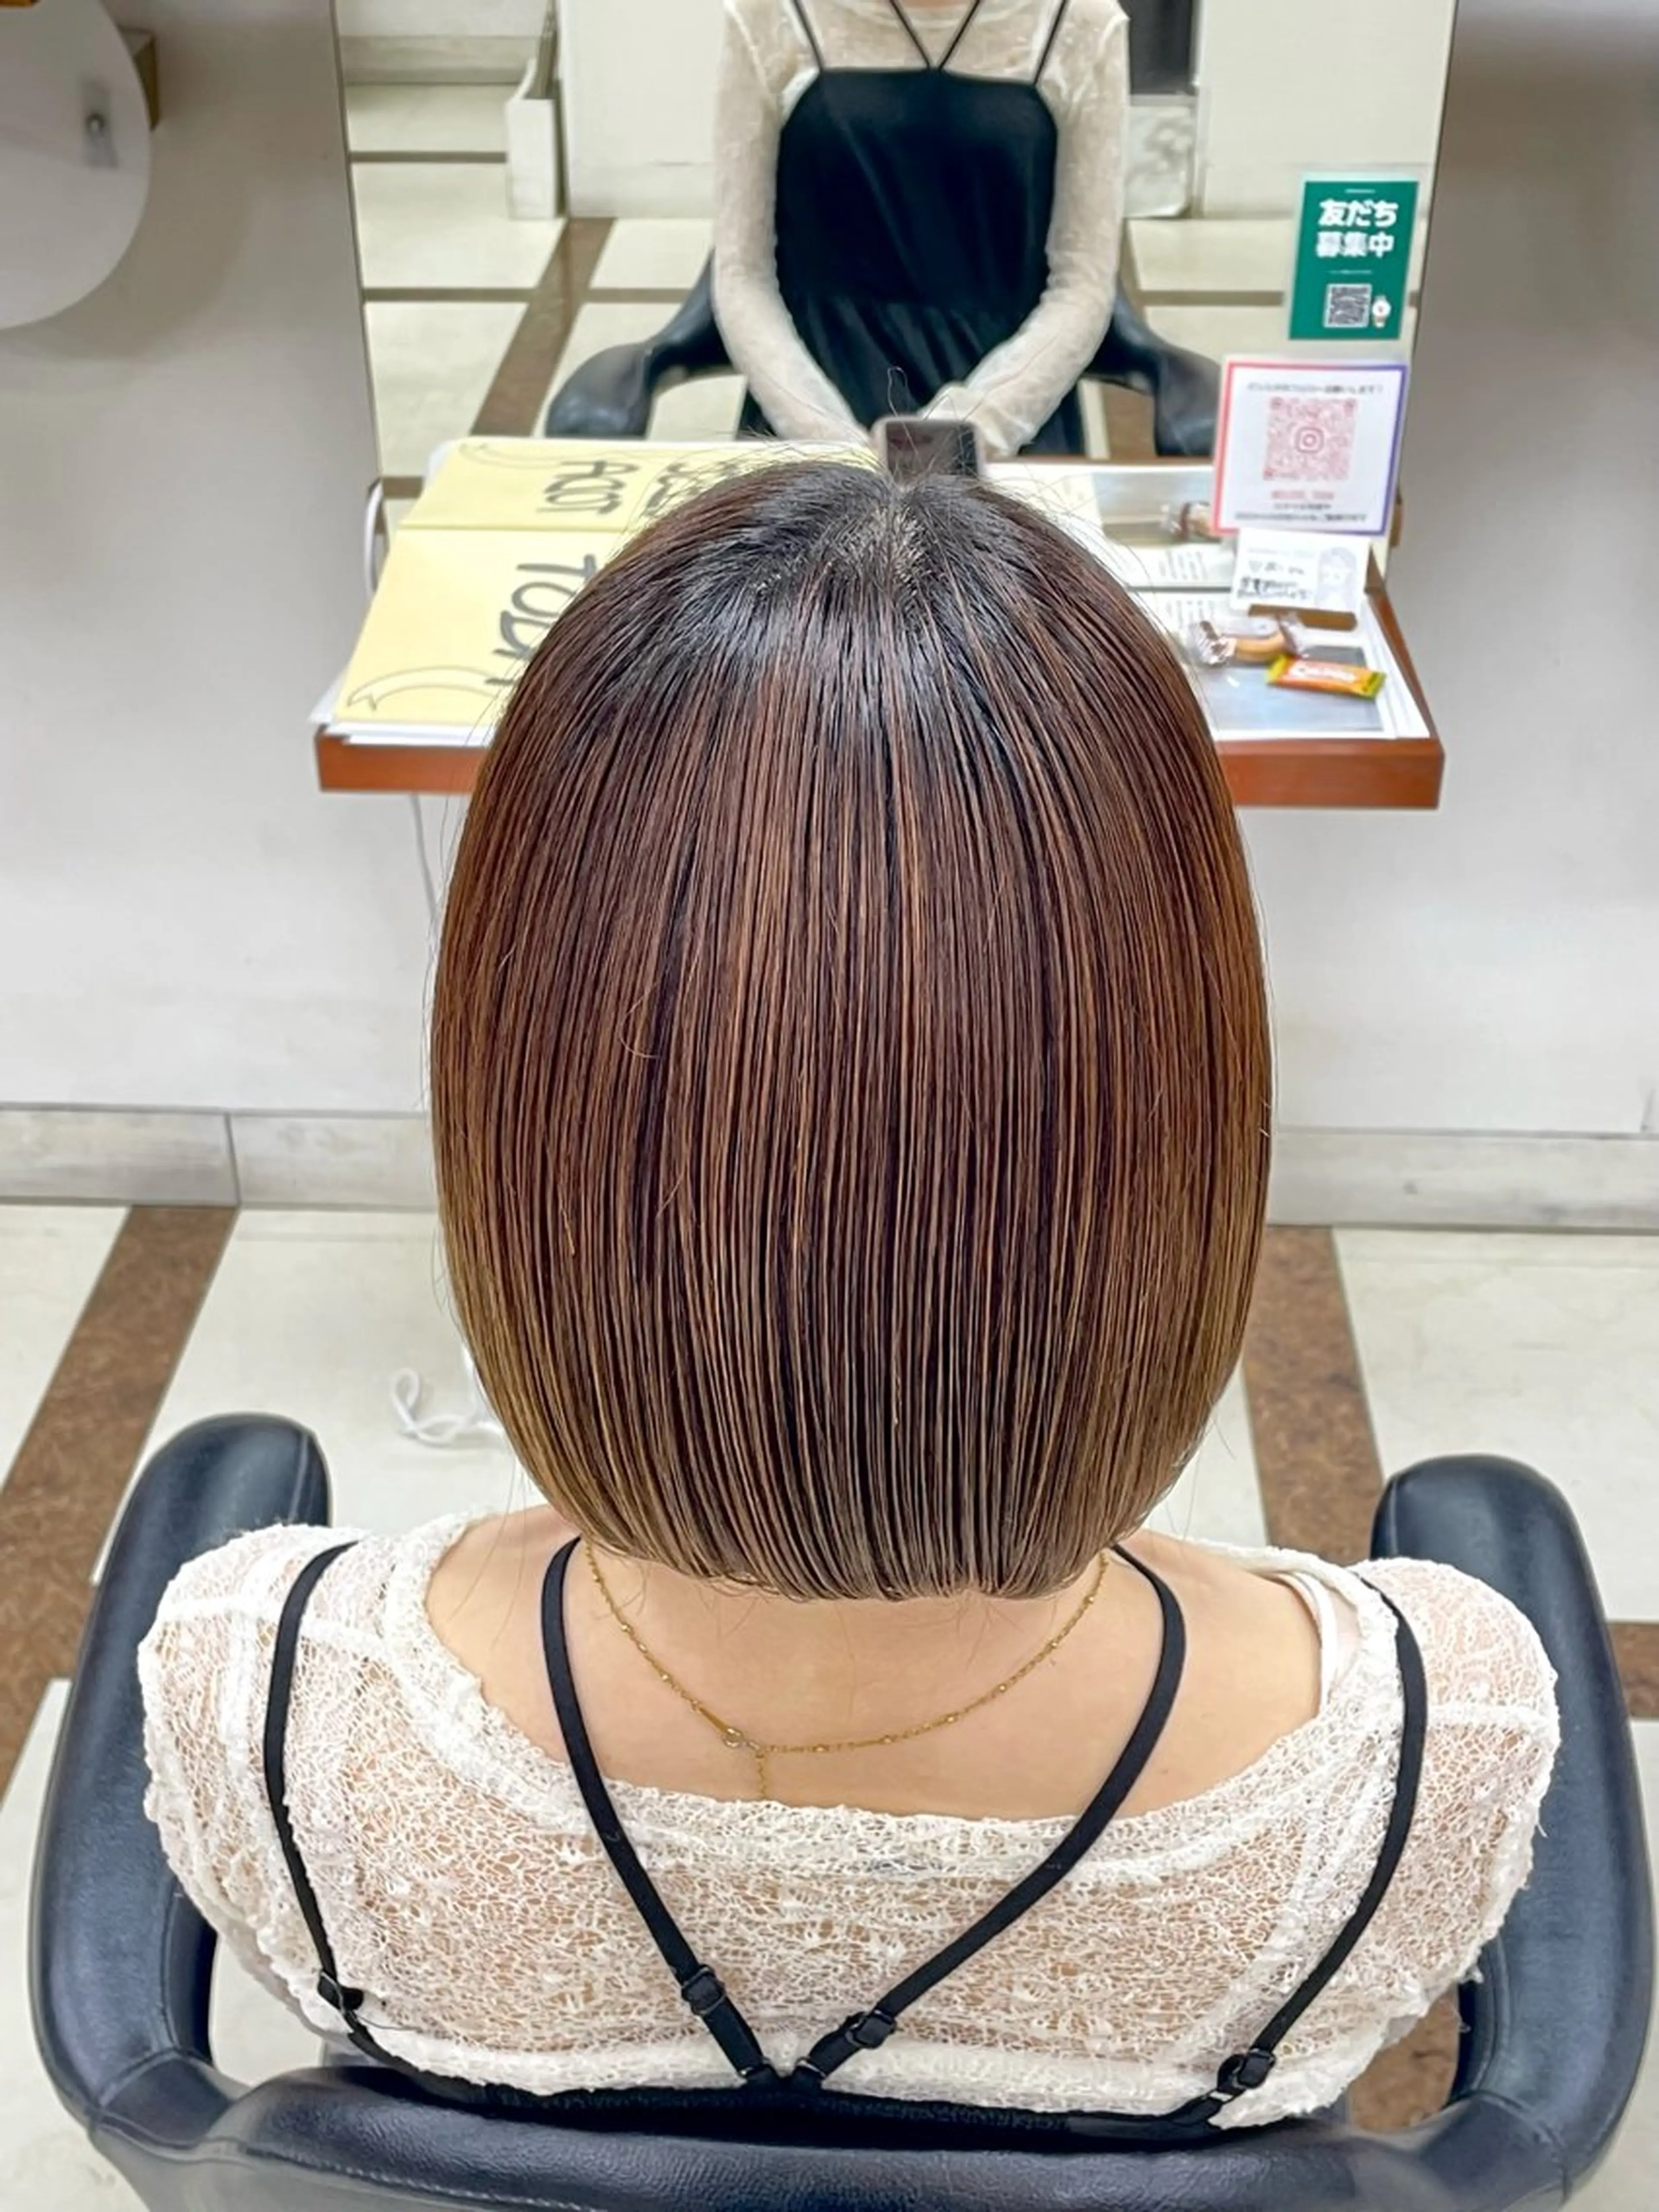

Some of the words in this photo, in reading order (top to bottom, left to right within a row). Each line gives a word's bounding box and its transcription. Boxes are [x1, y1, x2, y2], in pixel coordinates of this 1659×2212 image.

[1318, 198, 1399, 228] 友だち
[1316, 231, 1395, 258] 募集中
